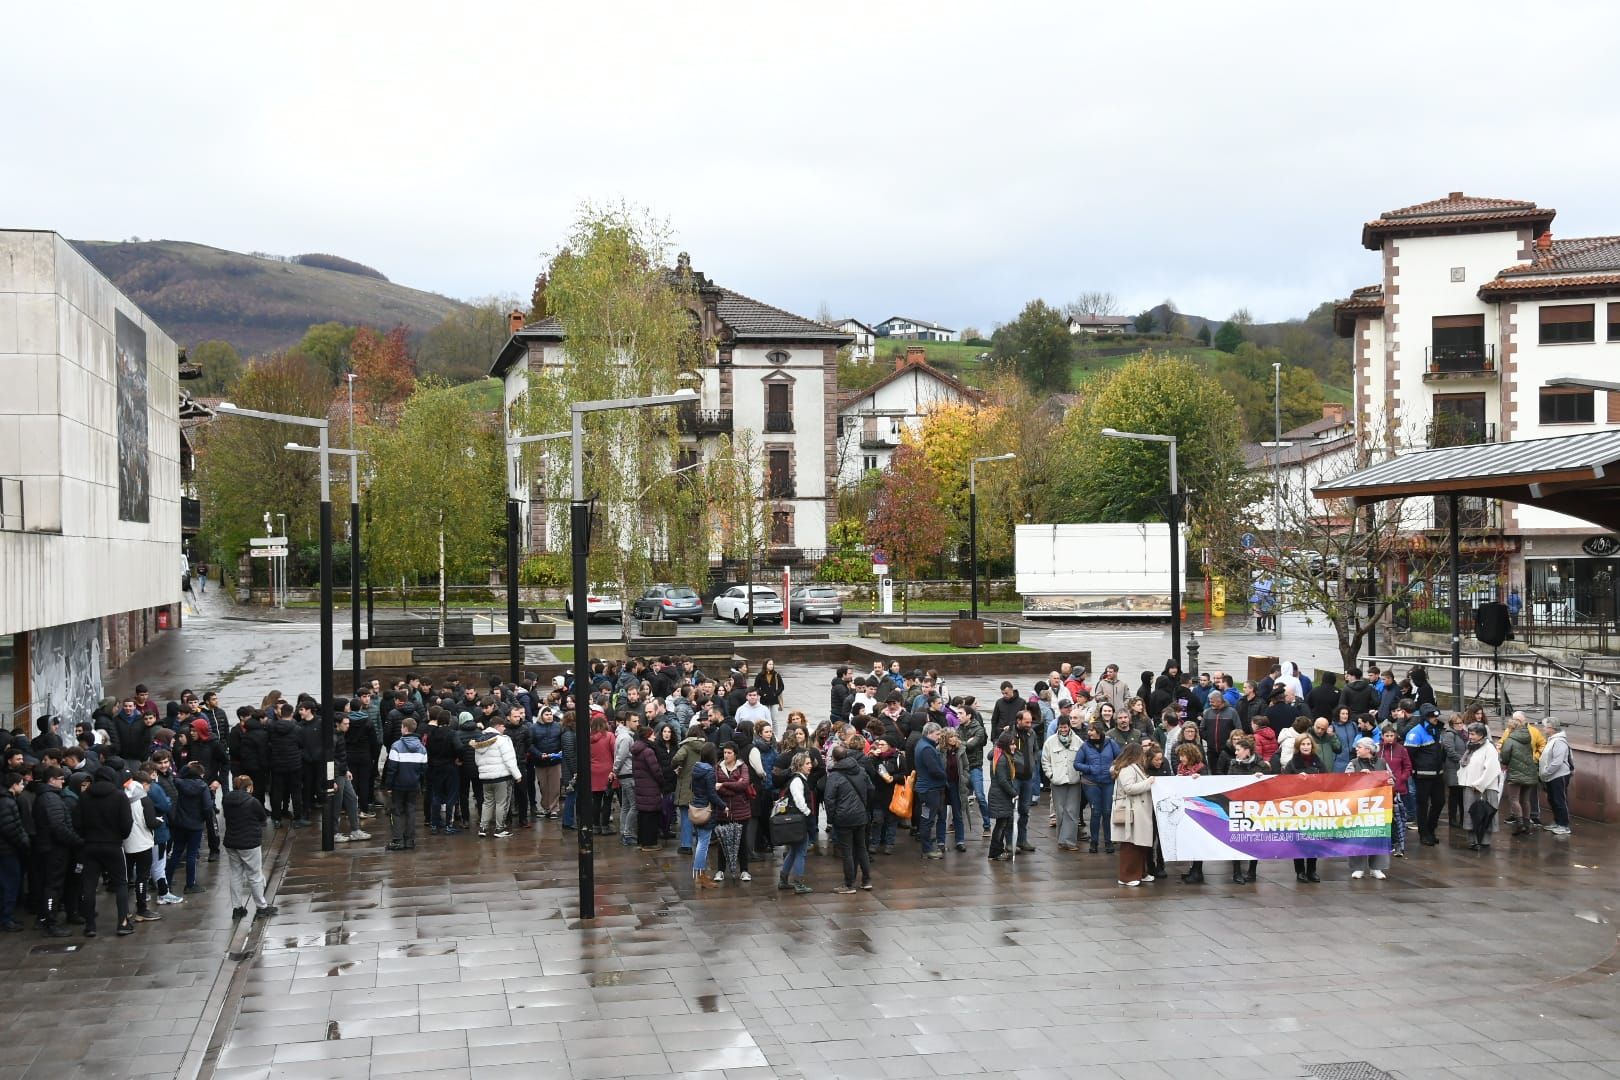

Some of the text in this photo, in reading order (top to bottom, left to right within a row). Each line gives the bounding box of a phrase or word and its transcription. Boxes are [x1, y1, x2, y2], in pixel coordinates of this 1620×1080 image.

[1229, 796, 1385, 818] ERASORIK EZ
[1229, 814, 1386, 831] ERANTZUNIK GABE
